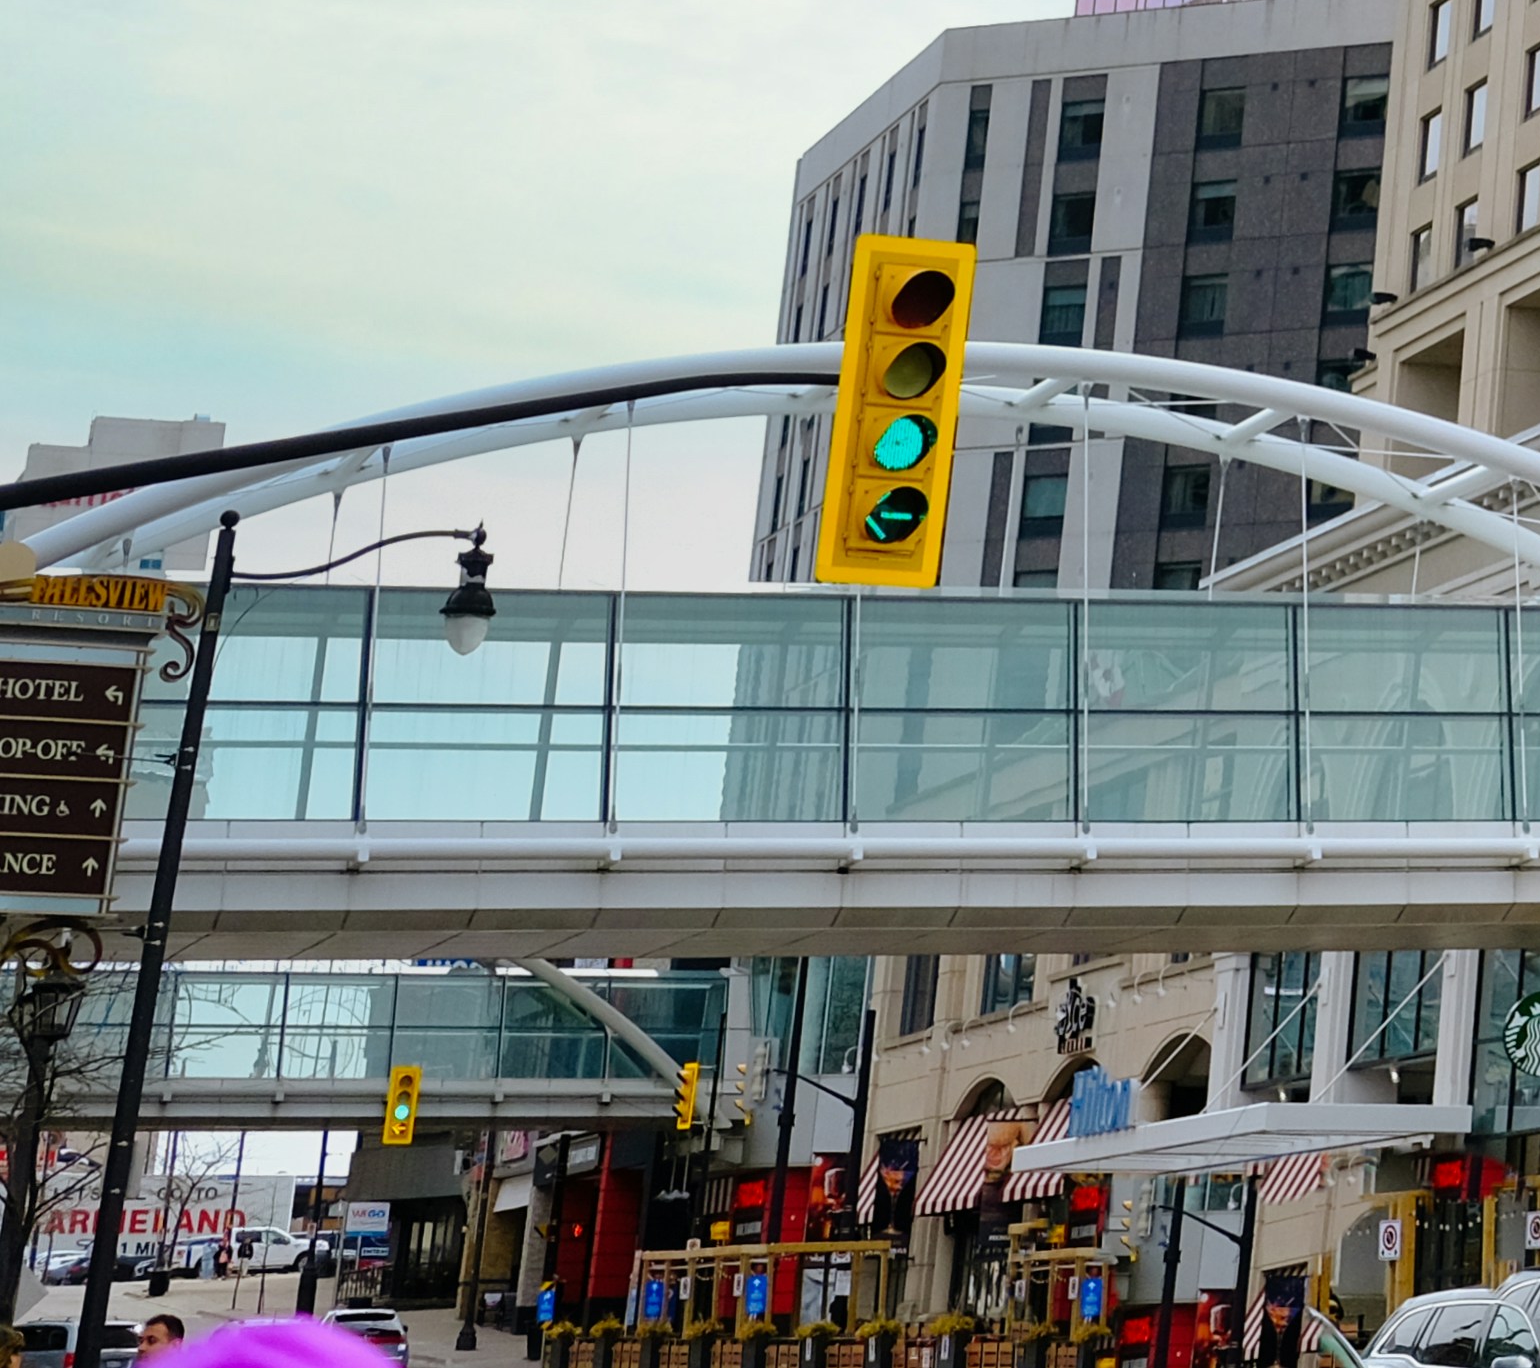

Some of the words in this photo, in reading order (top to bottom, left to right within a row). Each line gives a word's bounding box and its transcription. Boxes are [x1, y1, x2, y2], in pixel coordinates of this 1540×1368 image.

[31, 575, 166, 612] FALLSVIEW
[31, 610, 157, 627] RESORT
[0, 678, 84, 701] HOTEL
[0, 793, 50, 816] ING
[0, 852, 57, 875] NCE
[196, 1186, 218, 1201] TO
